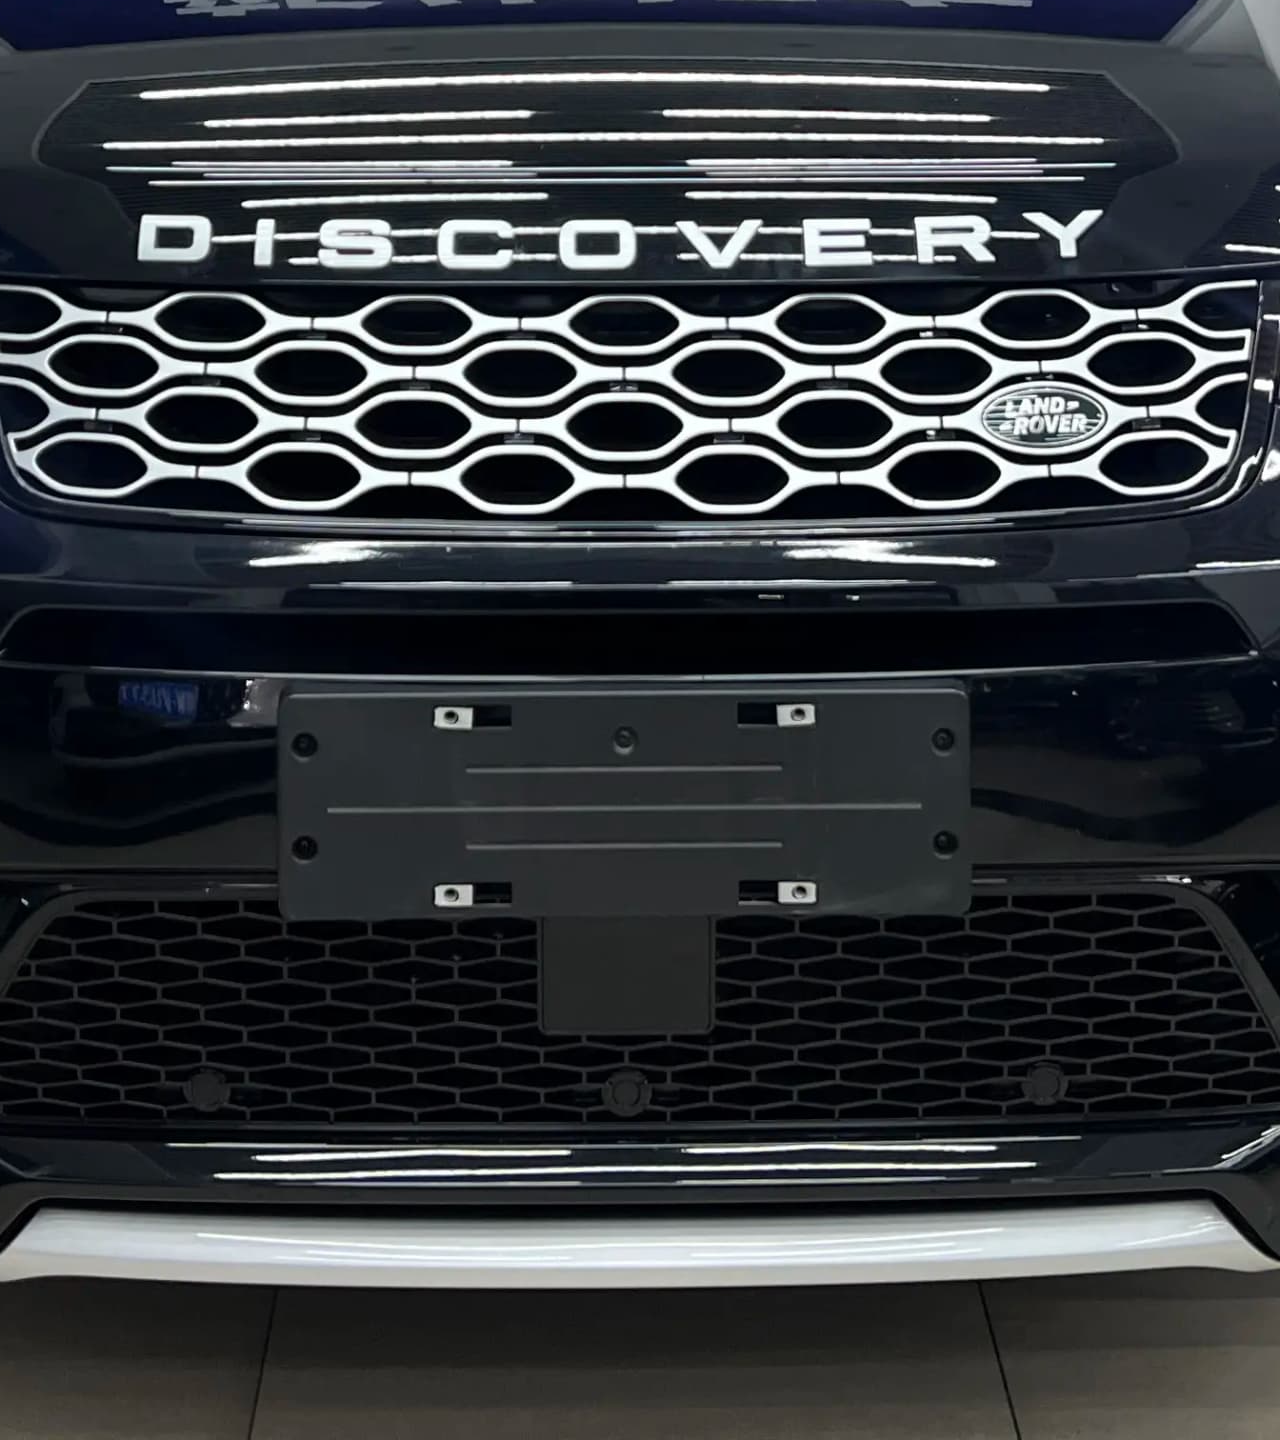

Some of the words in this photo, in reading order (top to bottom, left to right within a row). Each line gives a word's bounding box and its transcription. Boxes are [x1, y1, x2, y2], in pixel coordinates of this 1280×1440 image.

[138, 209, 1104, 269] DISCOVERY
[1005, 396, 1066, 418] LAND
[1013, 413, 1088, 435] ROVER
